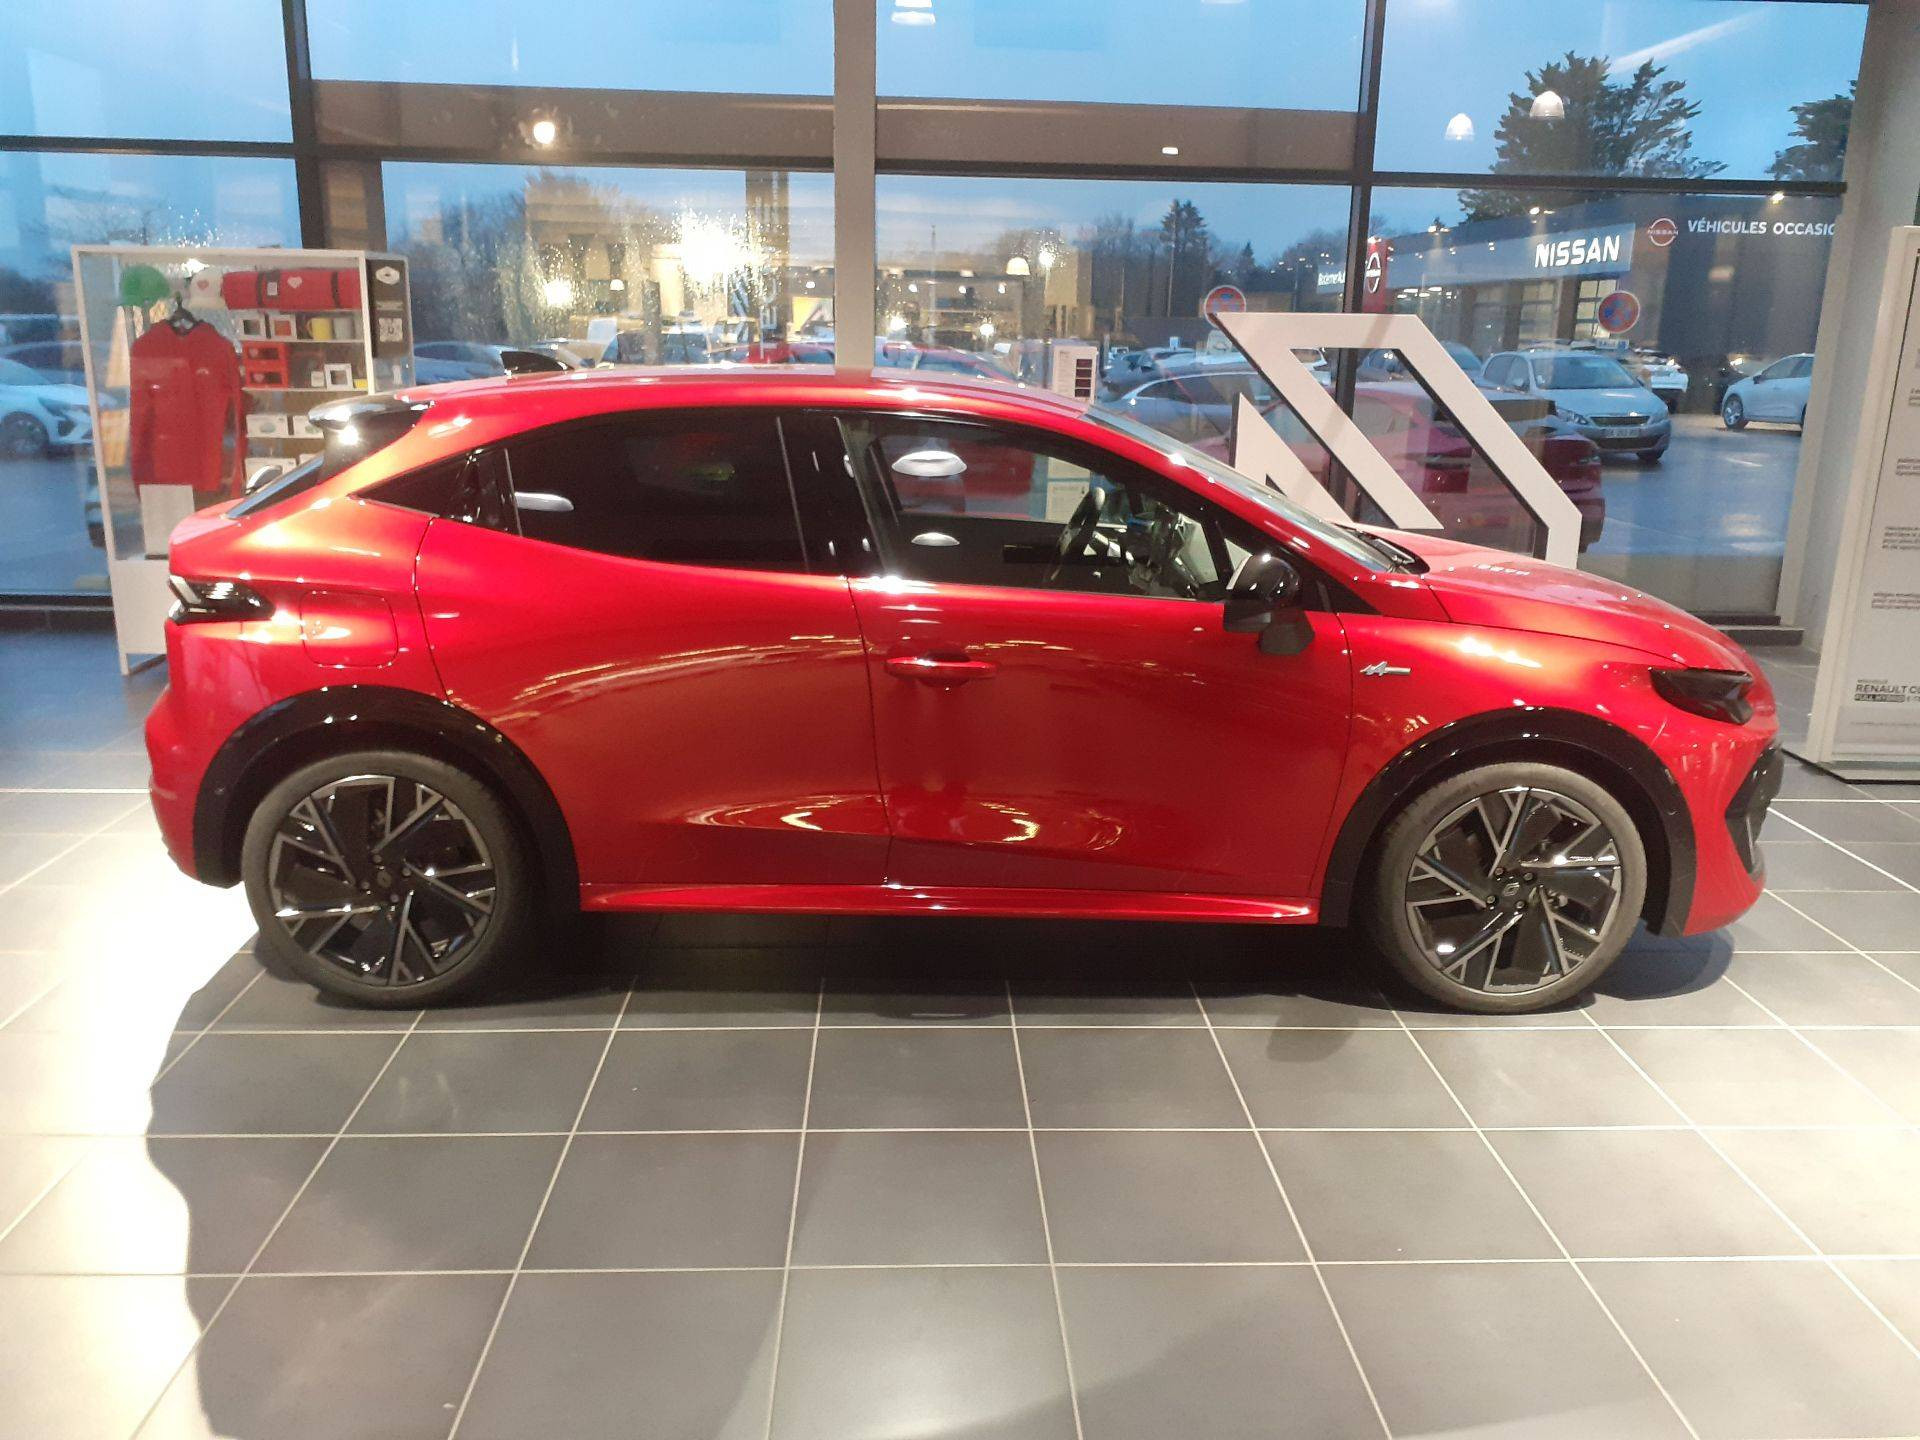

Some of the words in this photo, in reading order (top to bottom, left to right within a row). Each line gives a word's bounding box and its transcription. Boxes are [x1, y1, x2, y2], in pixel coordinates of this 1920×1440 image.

[1687, 217, 1767, 234] VÉHICULES
[1535, 235, 1620, 268] NISSAN
[1856, 684, 1908, 694] RENAULT
